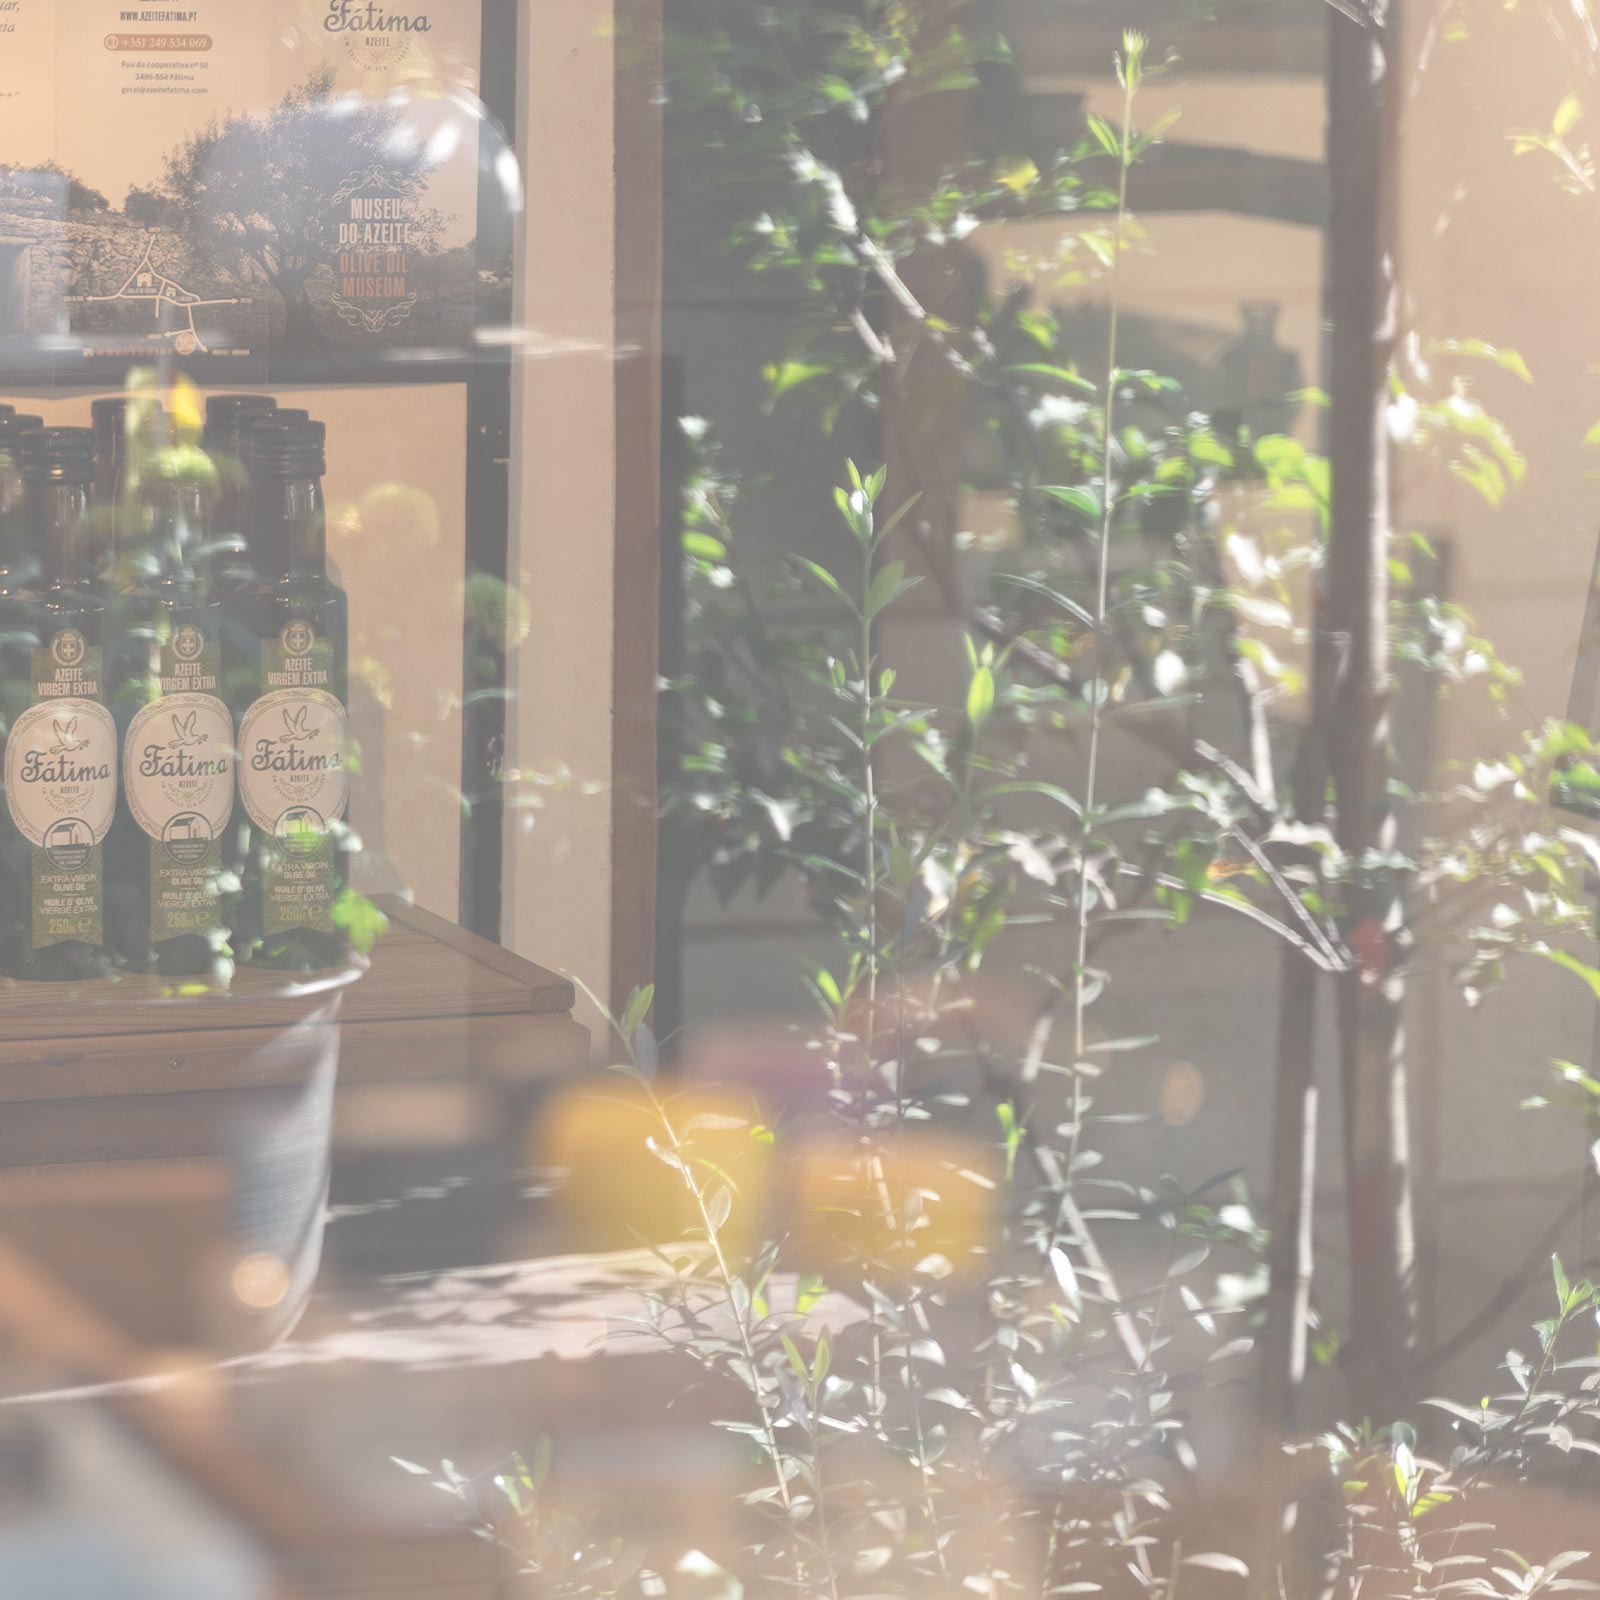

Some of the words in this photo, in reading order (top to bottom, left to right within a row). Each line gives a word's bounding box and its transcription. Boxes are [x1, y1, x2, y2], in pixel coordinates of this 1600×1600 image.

[119, 11, 198, 22] WWW.AZEITEFATIMA.PT
[324, 0, 432, 32] Fátima
[122, 37, 146, 48] +351
[149, 37, 167, 49] 249
[168, 38, 187, 49] 534
[189, 37, 207, 49] 069
[365, 37, 391, 47] AZEITE
[121, 60, 135, 69] Rua
[146, 61, 189, 70] cooperativa
[350, 198, 401, 220] MUSEU
[339, 222, 359, 244] DO
[364, 222, 411, 244] AZEITE
[340, 252, 381, 273] OLIVE
[386, 252, 409, 273] OIL
[342, 276, 406, 298] MUSEUM
[174, 663, 202, 676] AZEITE
[285, 658, 312, 671] AZEITE
[55, 668, 82, 681] AZEITE
[192, 675, 216, 689] EXTRA
[268, 671, 300, 686] VIRGEM
[303, 671, 327, 684] EXTRA
[38, 683, 70, 696] VIRGEM
[73, 681, 97, 695] EXTRA
[21, 750, 110, 783] Fátima
[140, 744, 228, 777] Fátima
